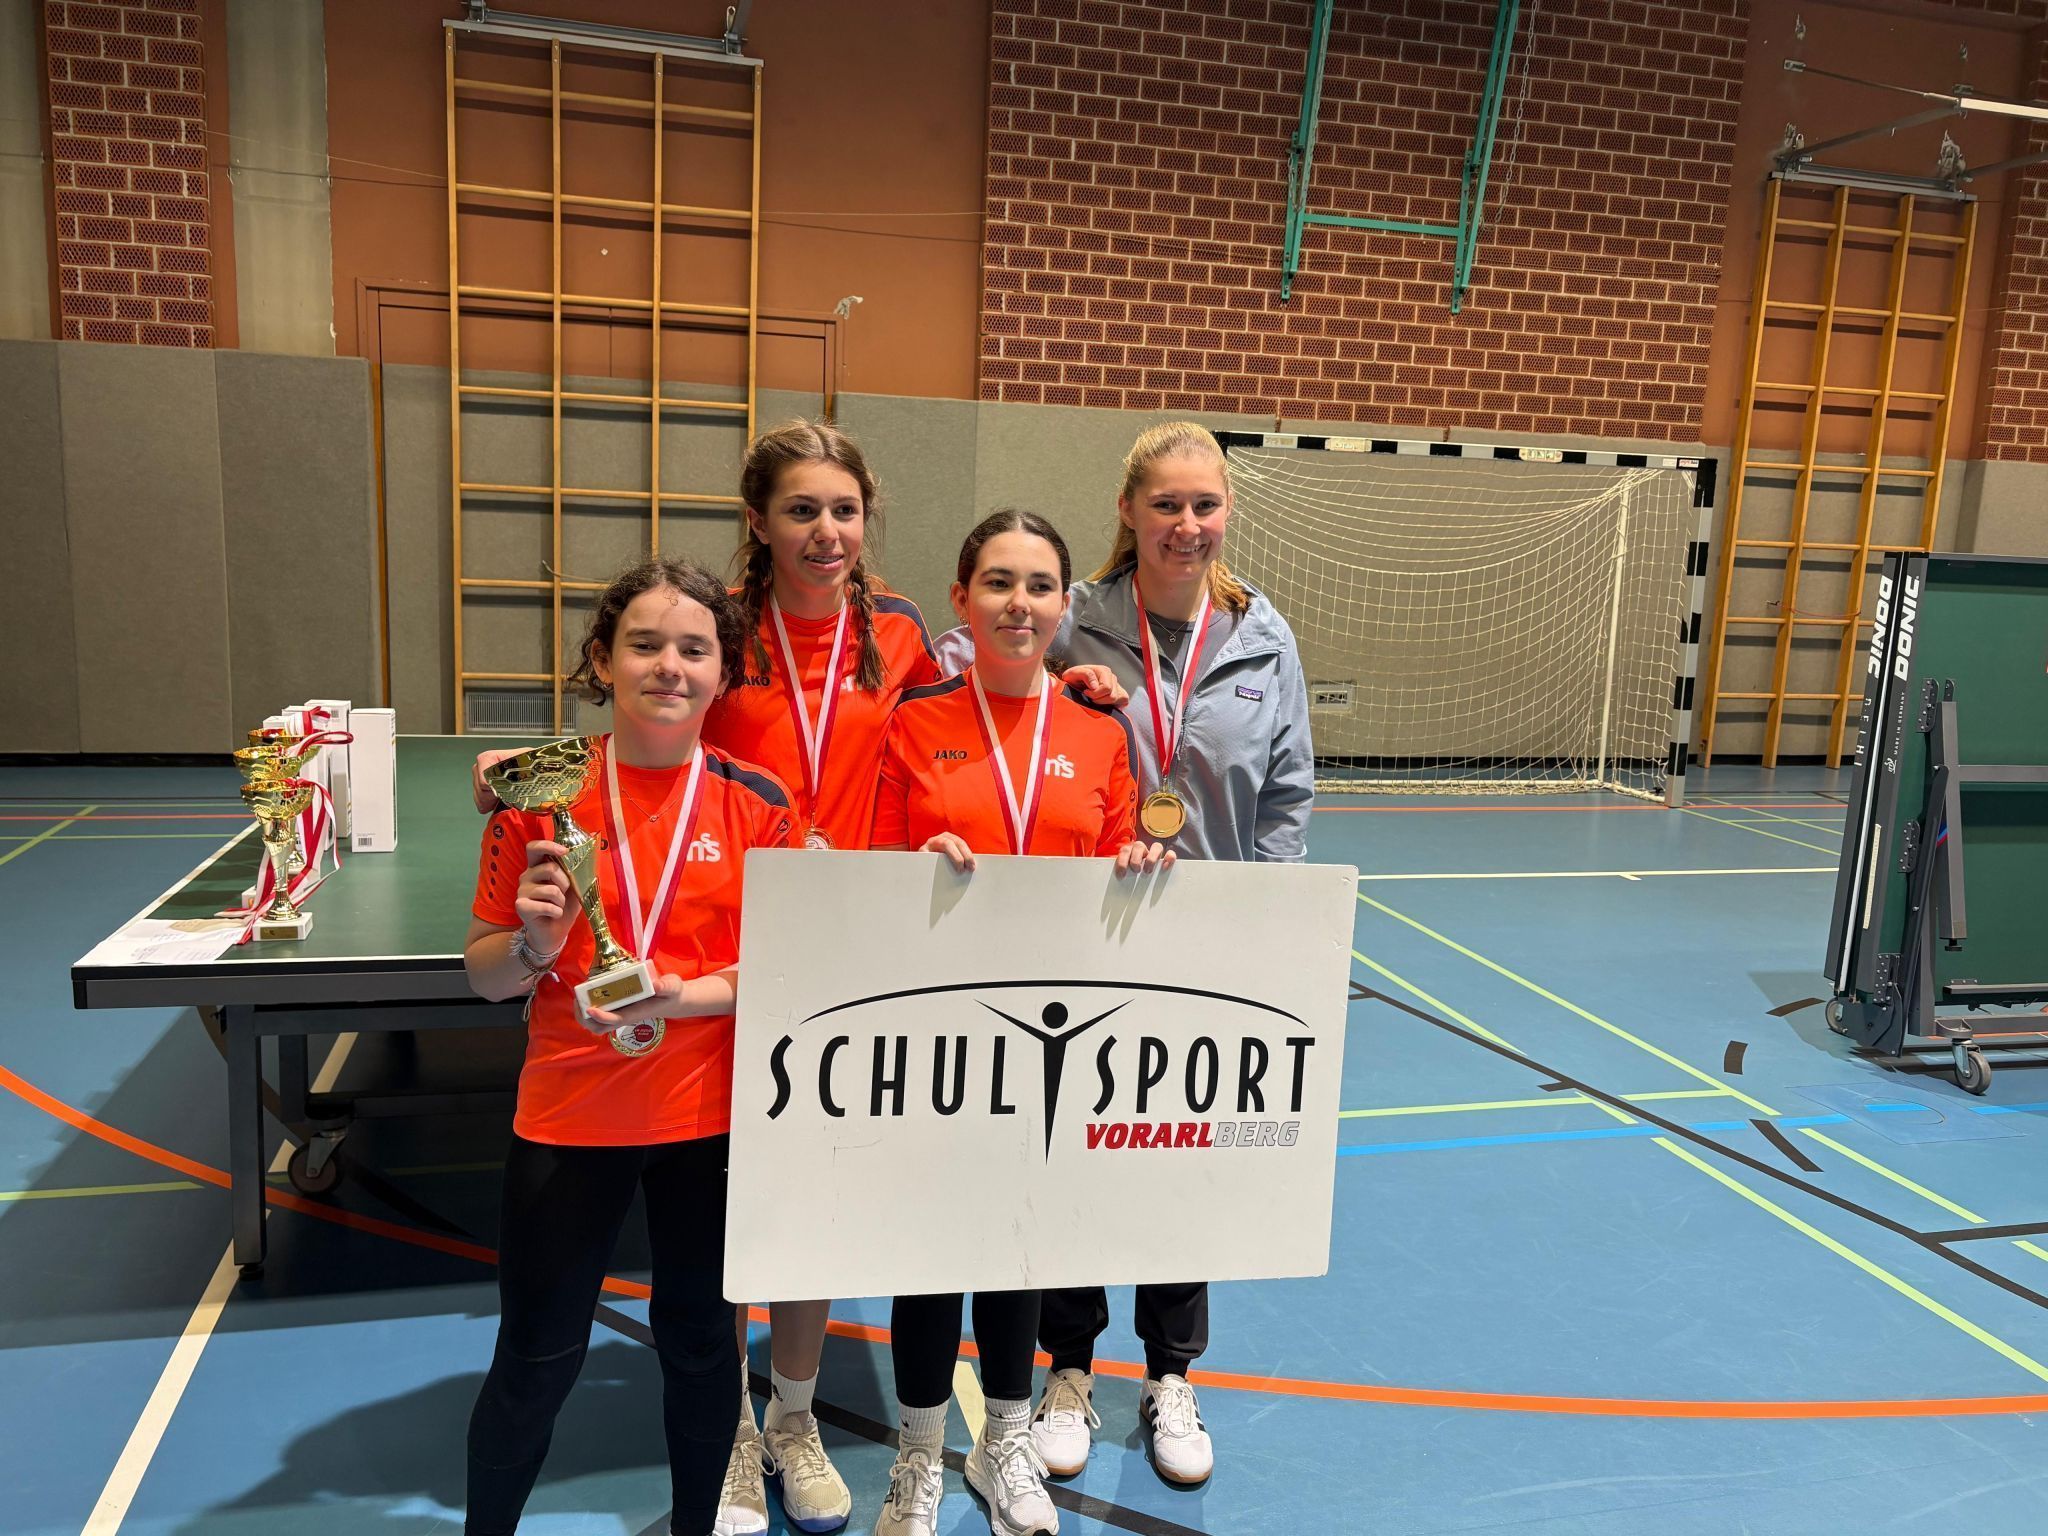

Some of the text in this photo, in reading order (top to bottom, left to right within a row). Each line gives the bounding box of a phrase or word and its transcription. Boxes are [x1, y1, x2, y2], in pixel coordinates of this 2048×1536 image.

[1867, 574, 1893, 679] DONIC
[1894, 574, 1920, 682] DONIC
[743, 675, 771, 687] AKO
[933, 750, 968, 760] JAKO
[766, 1034, 1316, 1120] SCHUL SPORT
[1086, 1121, 1301, 1150] VORARLBERG
